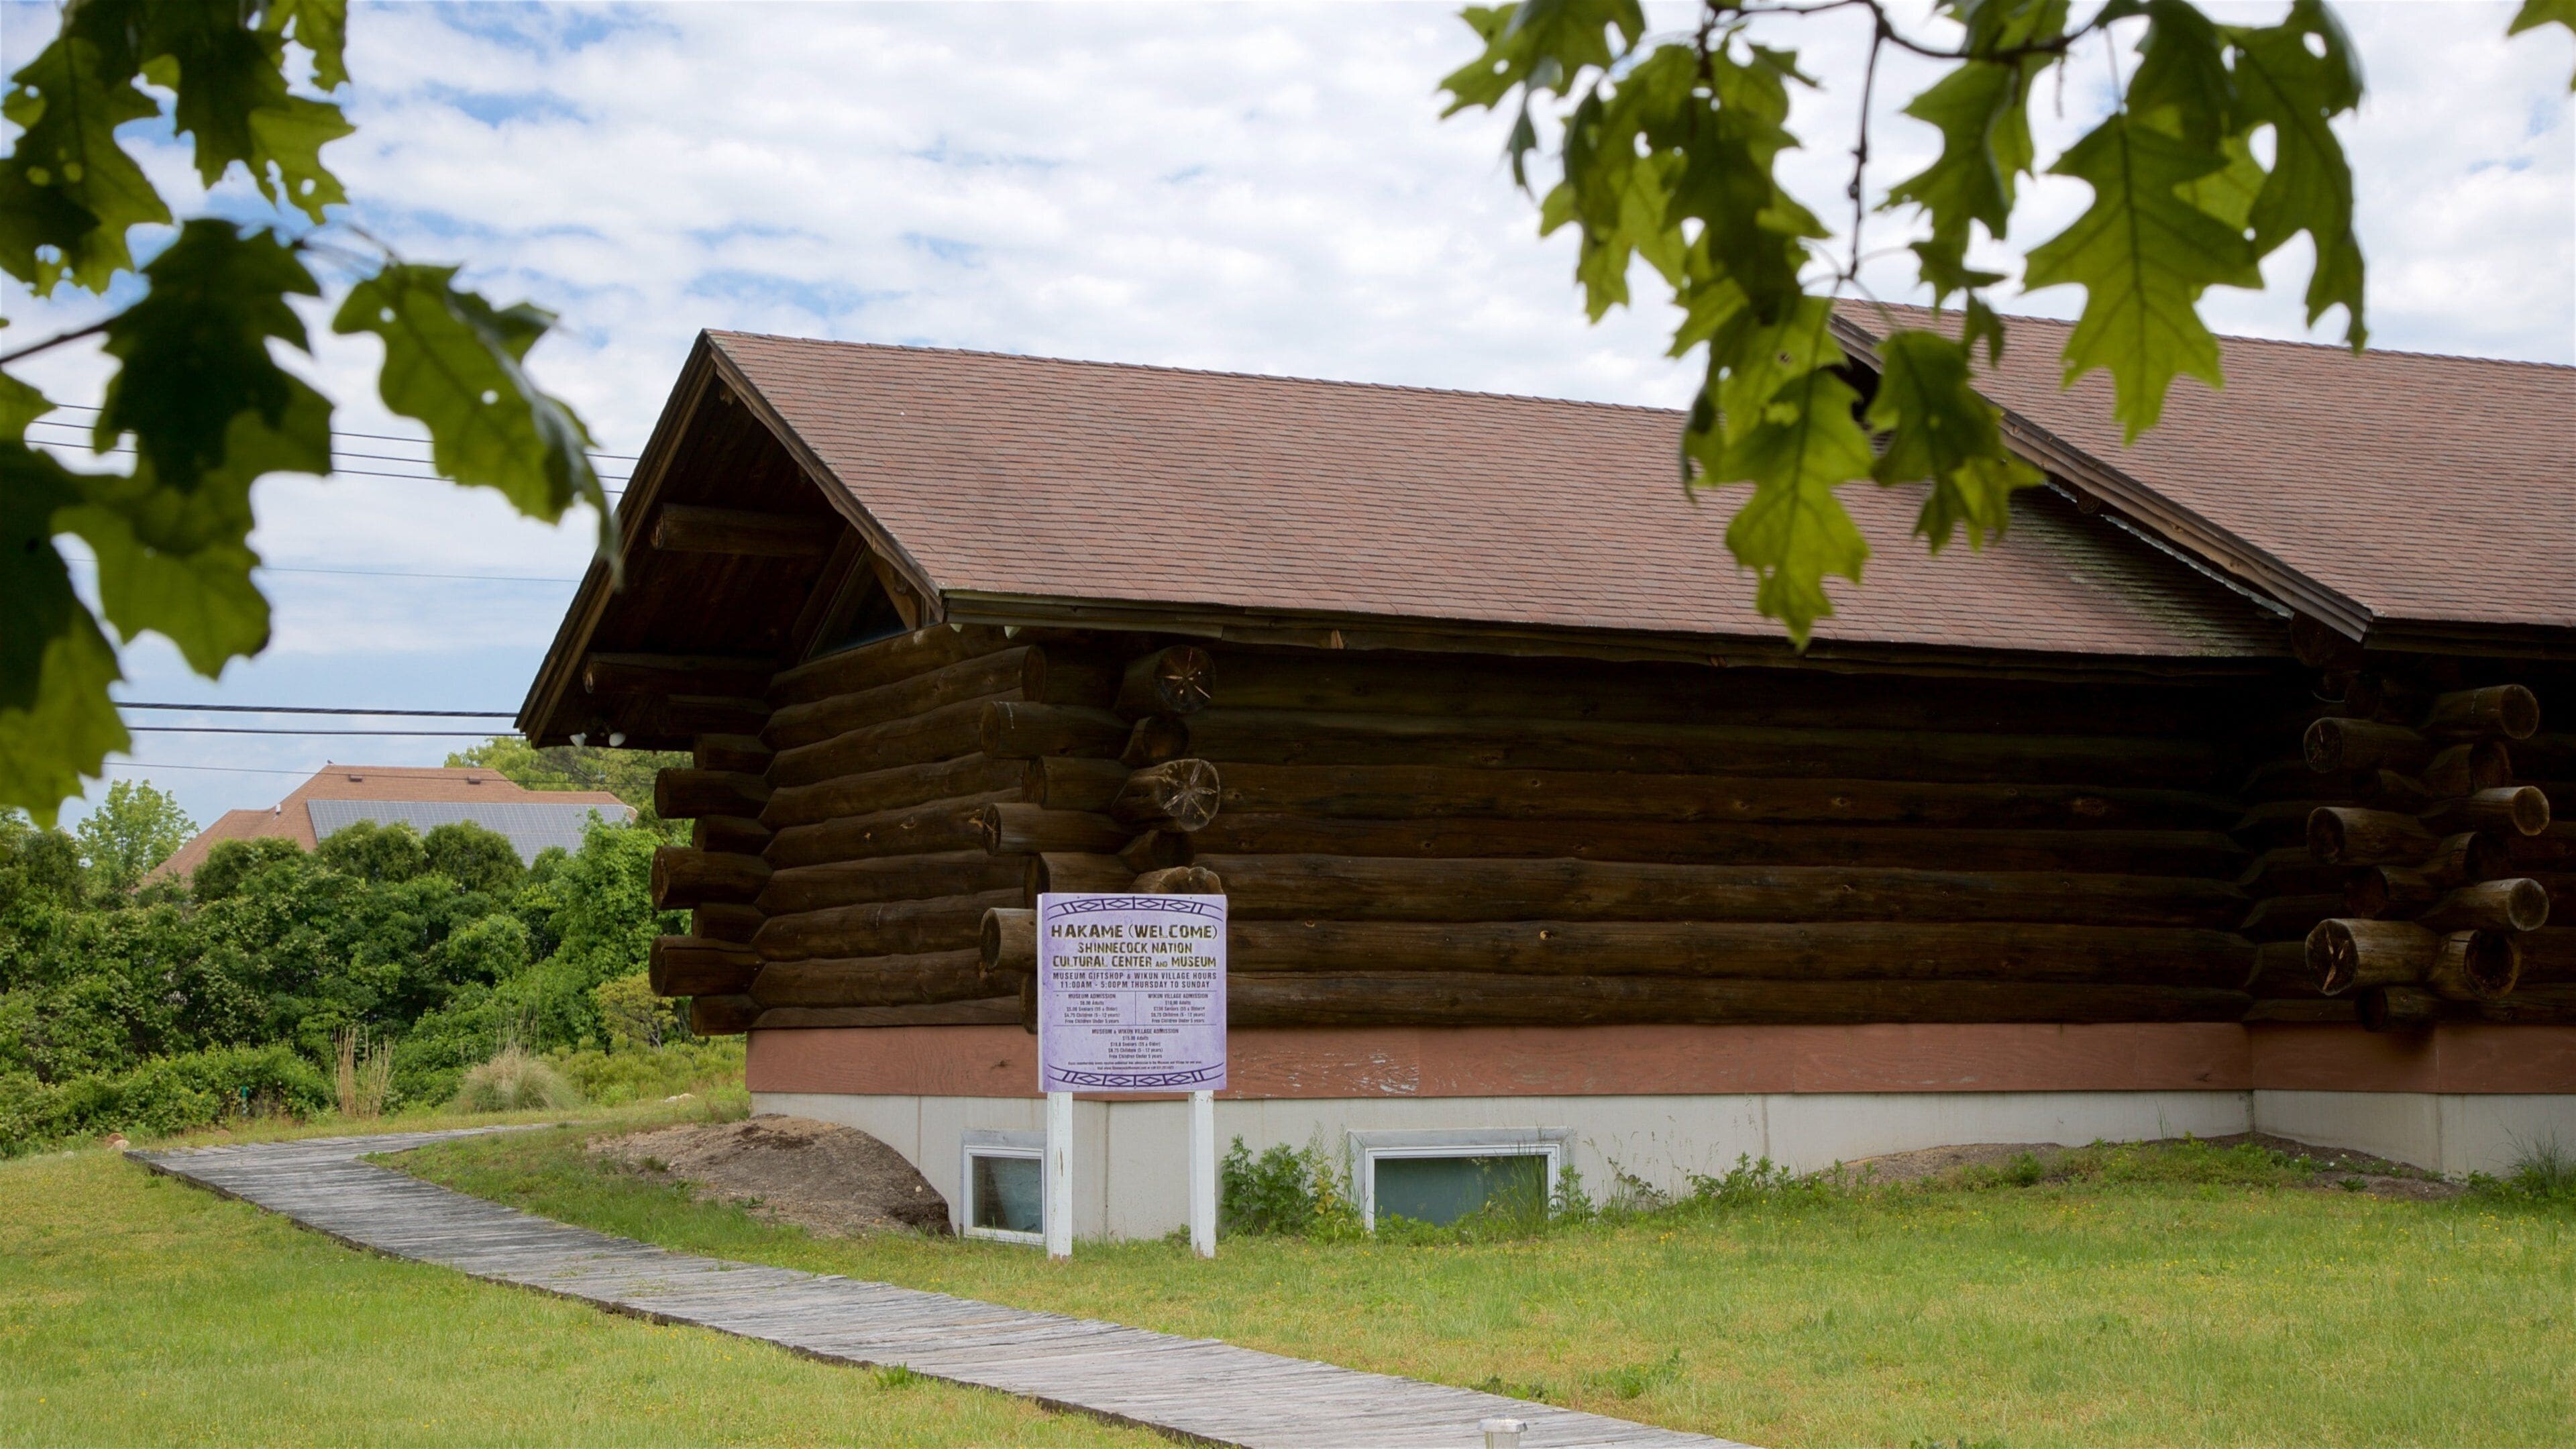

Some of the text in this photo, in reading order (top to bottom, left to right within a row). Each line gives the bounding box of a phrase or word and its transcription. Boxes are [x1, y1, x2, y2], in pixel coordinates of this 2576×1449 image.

[1051, 924, 1218, 938] HAKAME (WELCOME)
[1077, 942, 1193, 954] SHINNECOCK NATION
[1053, 955, 1106, 967] CULTURAL
[1112, 955, 1152, 967] CENTER
[1171, 956, 1216, 967] MUSEUM
